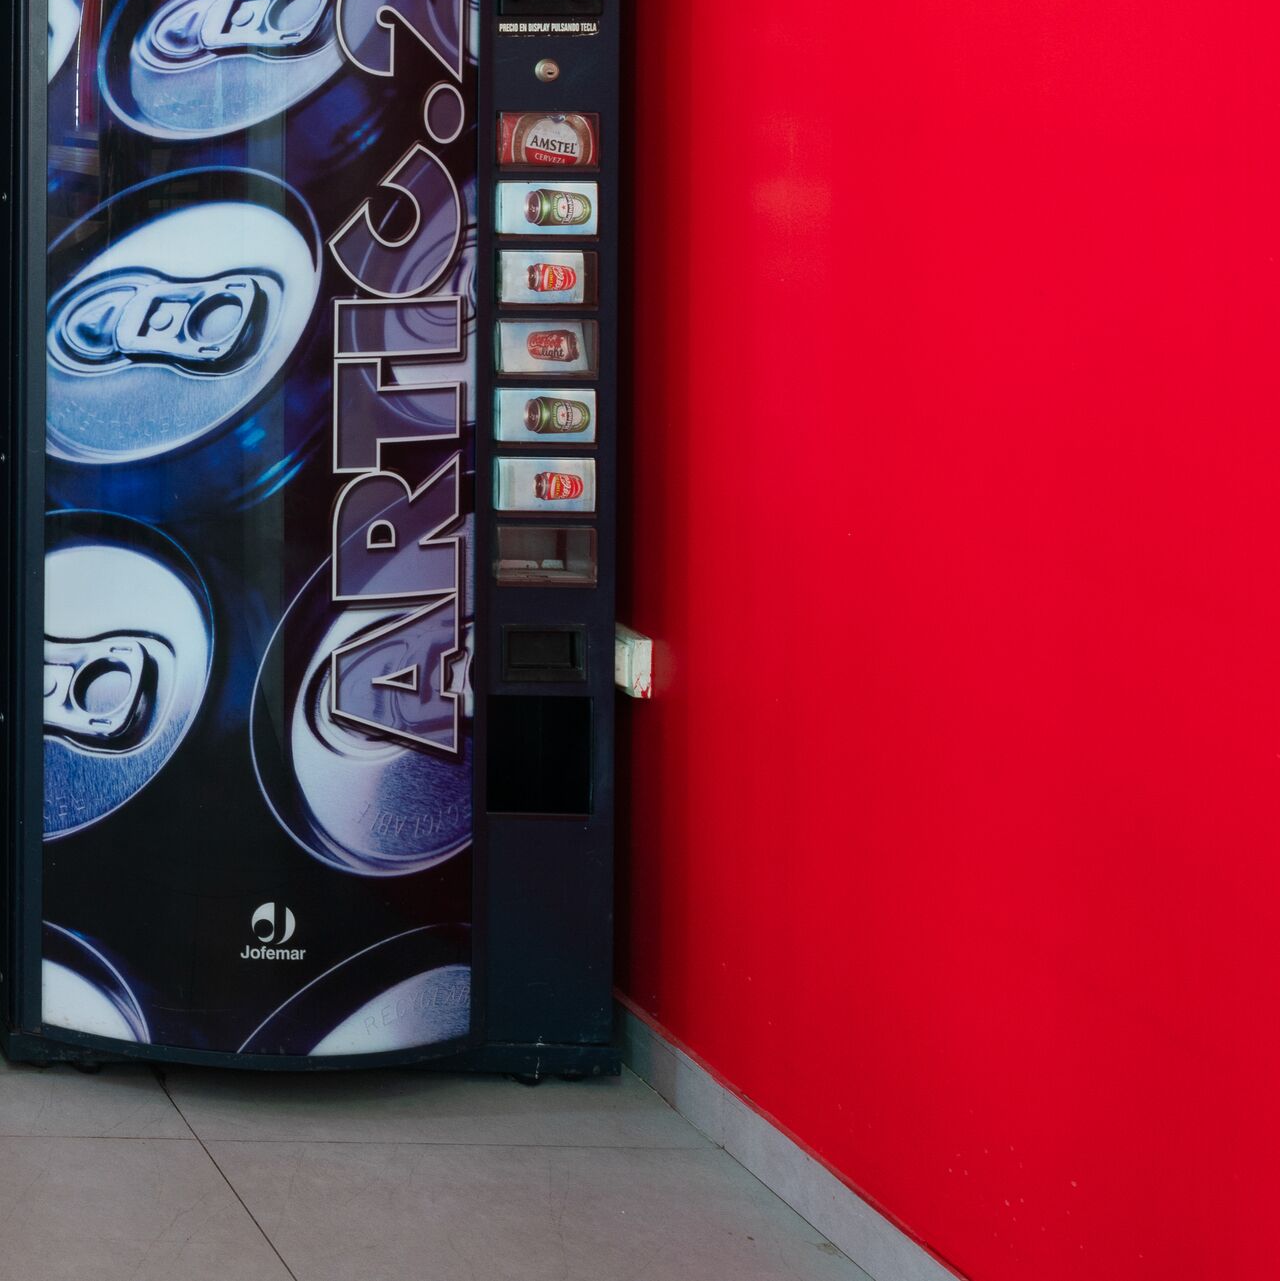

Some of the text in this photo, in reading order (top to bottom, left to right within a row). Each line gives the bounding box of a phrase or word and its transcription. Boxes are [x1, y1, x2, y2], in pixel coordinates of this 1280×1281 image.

[499, 23, 597, 32] PRECIO EN DISPLAY PULSANDO TECLA
[530, 135, 577, 155] AMSTEL
[535, 153, 566, 164] CERVEZA
[240, 944, 306, 960] Jofemar
